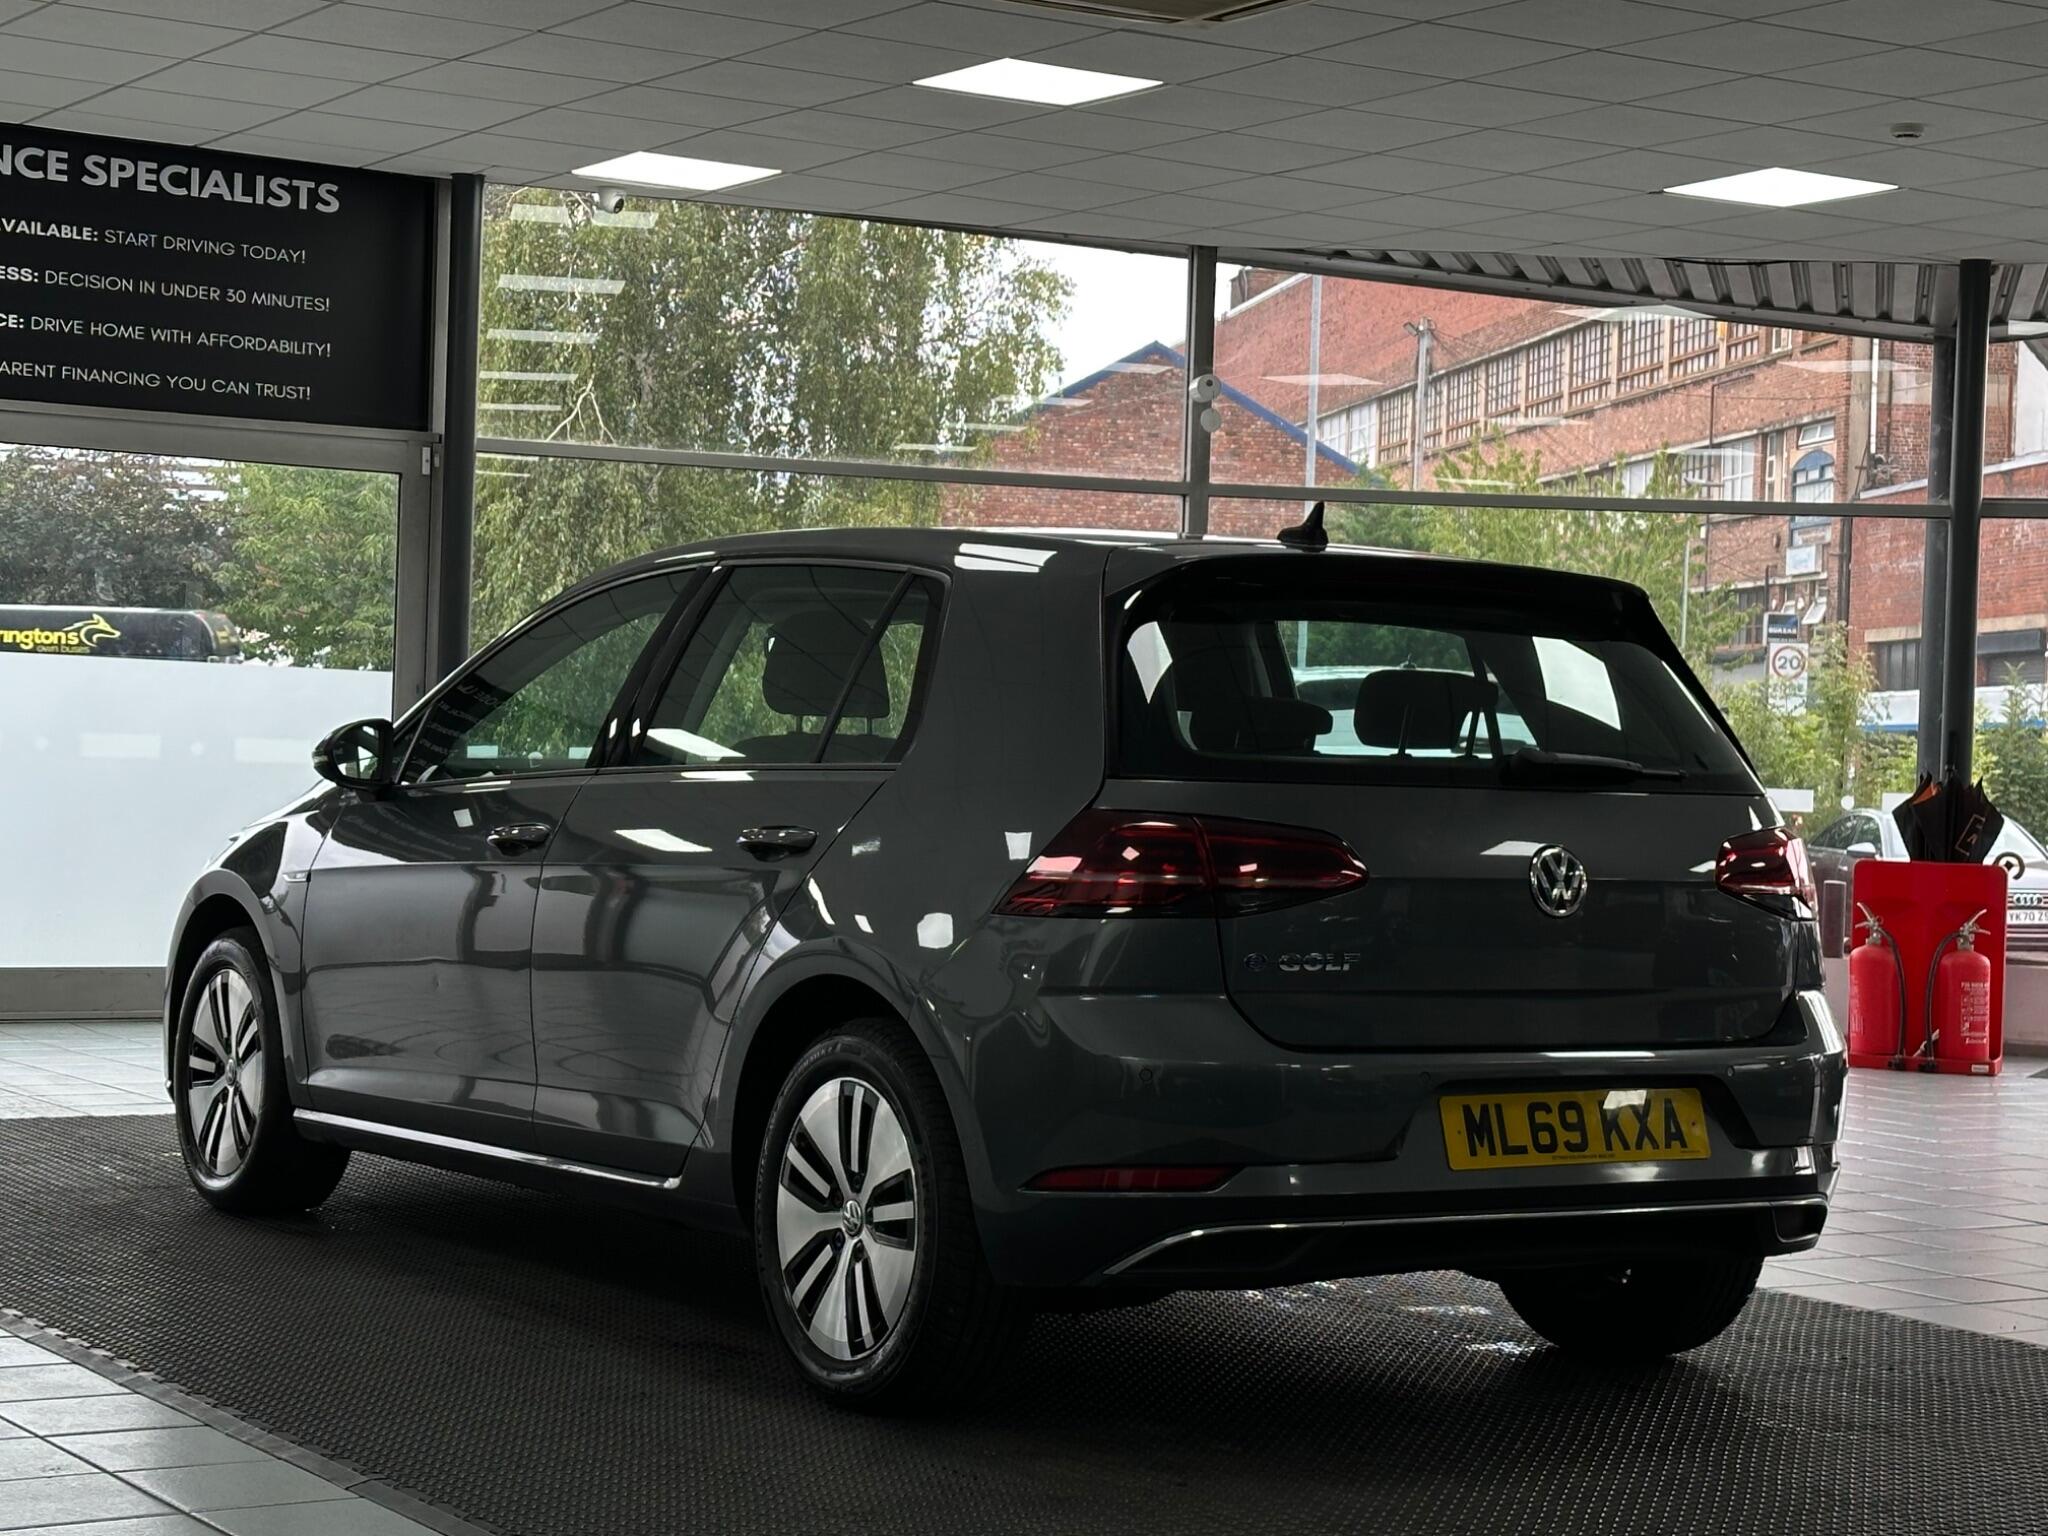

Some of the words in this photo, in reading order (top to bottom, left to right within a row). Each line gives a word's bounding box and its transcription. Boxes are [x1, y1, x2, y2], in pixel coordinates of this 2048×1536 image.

[81, 154, 340, 213] SPECIALISTS
[0, 217, 98, 242] VAILABLE:
[104, 229, 157, 248] START
[163, 236, 235, 256] DRIVING
[240, 244, 306, 264] TODAY!
[45, 270, 133, 292] DECISION
[139, 280, 156, 294] IN
[161, 282, 221, 301] UNDER
[226, 288, 246, 304] 30
[252, 291, 330, 312] MINUTES!
[31, 316, 84, 335] DRIVE
[90, 322, 145, 340] HOME
[151, 327, 191, 345] WITH
[196, 332, 331, 358] AFFORDABILITY!
[0, 361, 56, 378] ARENT
[62, 366, 160, 387] FINANCING
[166, 375, 206, 391] YOU
[211, 379, 249, 395] CAN
[255, 382, 311, 401] TRUST!
[1778, 656, 1801, 670] 20
[1279, 952, 1361, 972] GOLF
[1461, 1100, 1589, 1157] ML69
[1597, 1096, 1689, 1152] KXA
